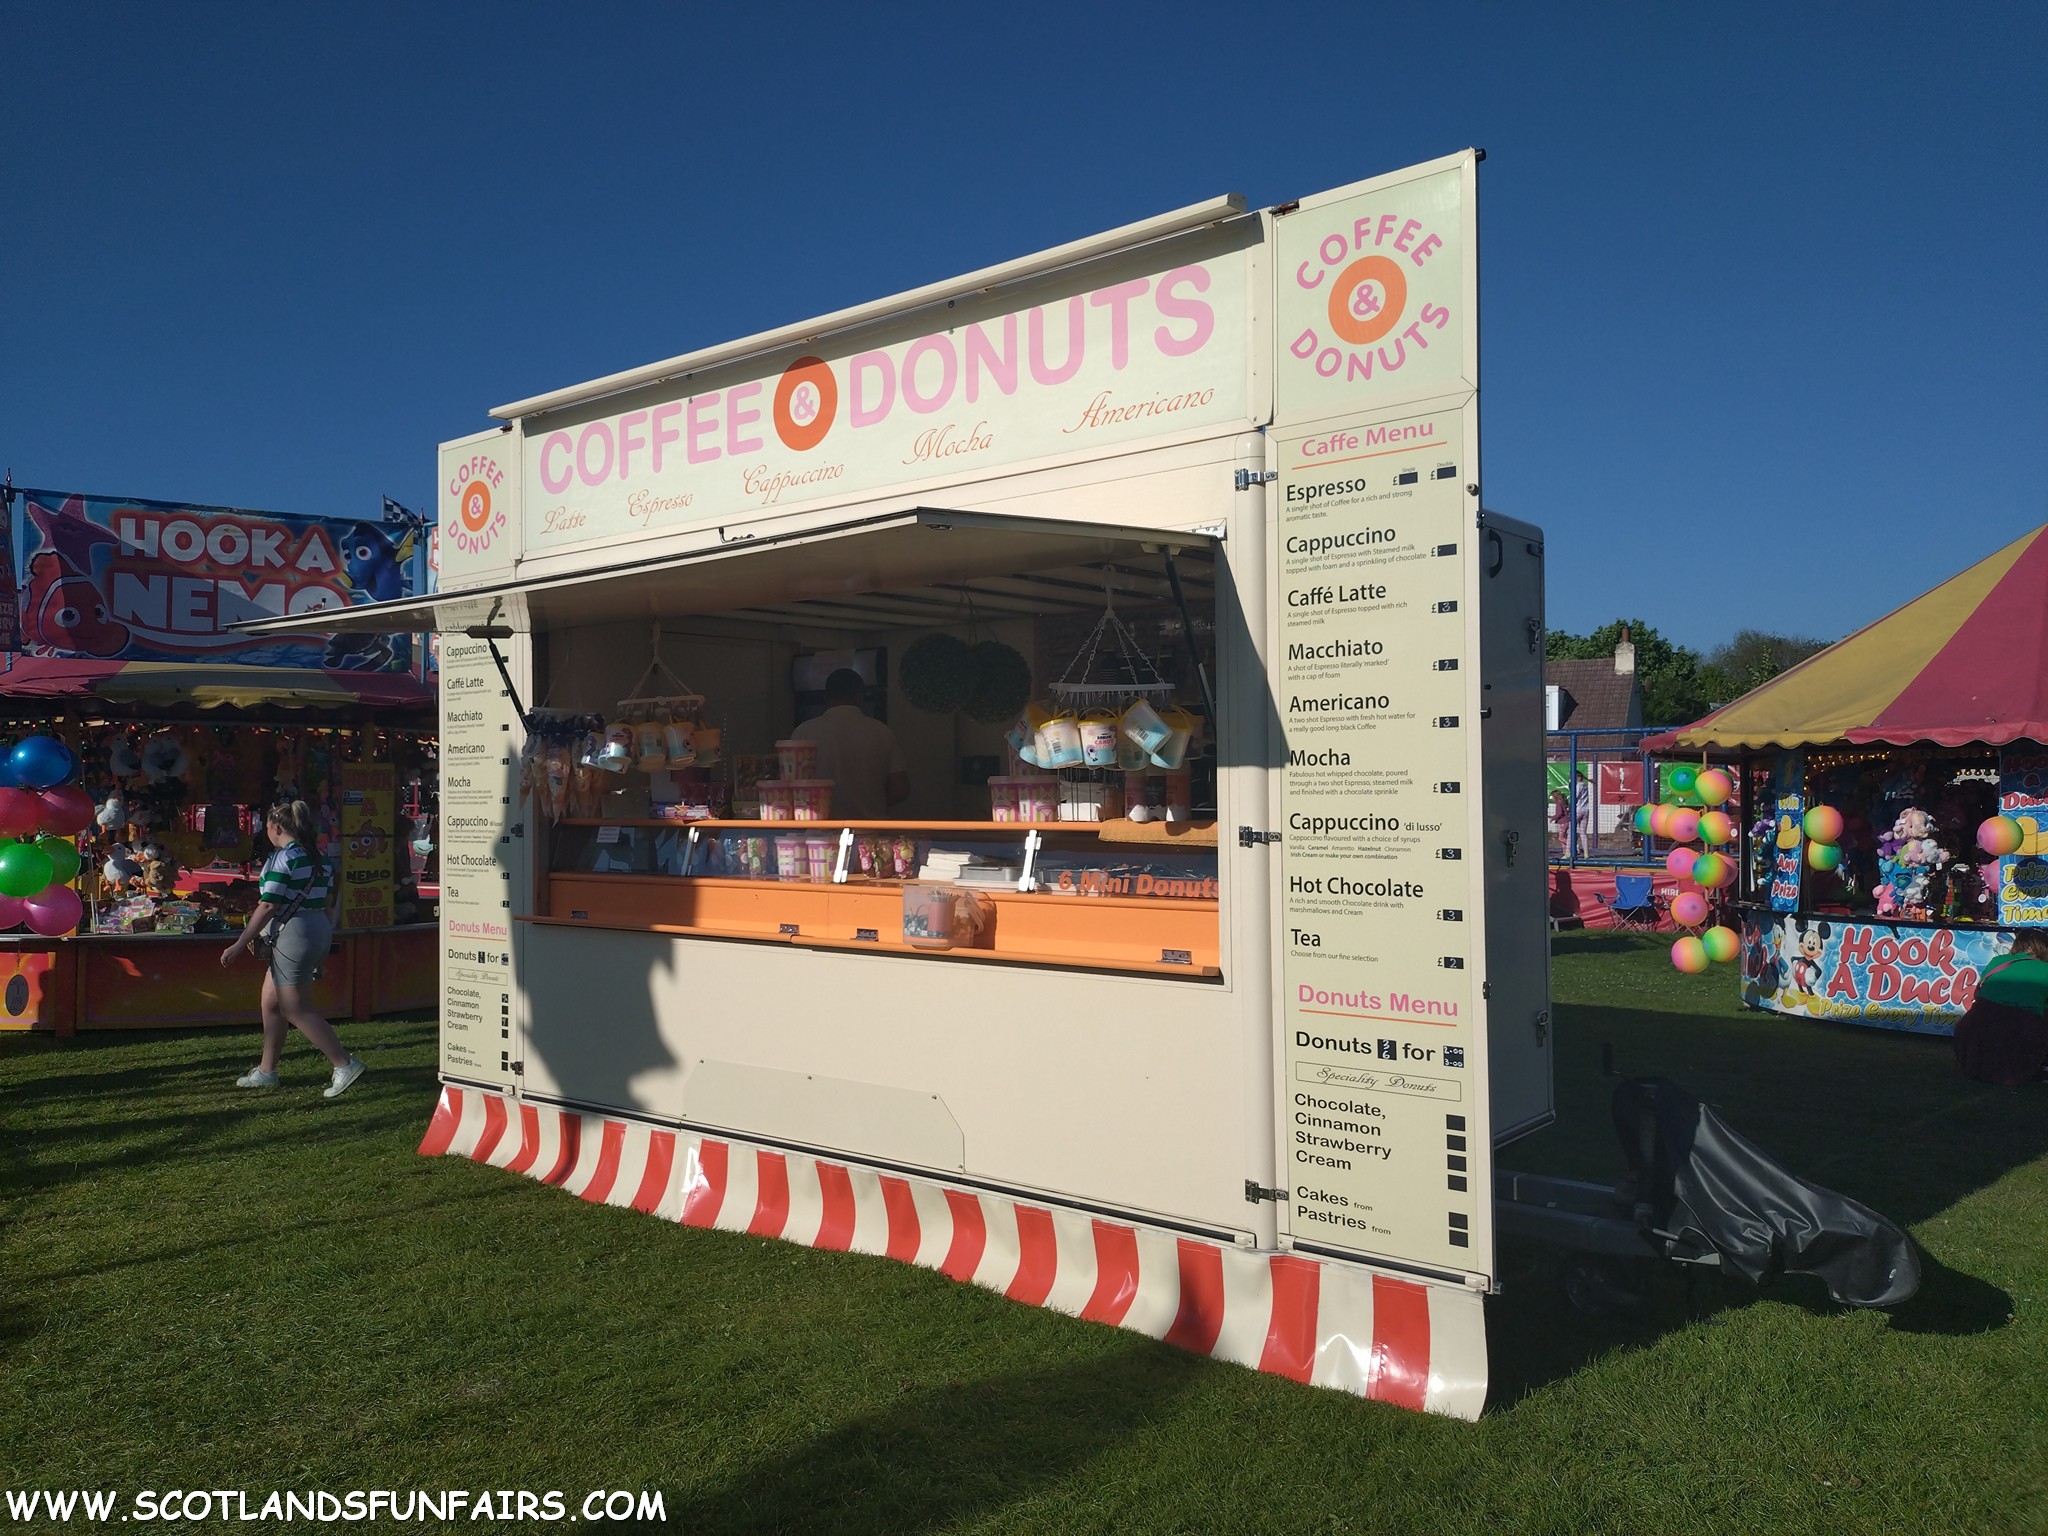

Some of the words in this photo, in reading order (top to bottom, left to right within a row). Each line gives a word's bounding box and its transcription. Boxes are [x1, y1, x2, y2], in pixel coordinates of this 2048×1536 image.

[1297, 215, 1443, 289] COFFEE
[1353, 284, 1380, 315] &
[1290, 303, 1449, 381] DONUTS
[540, 381, 762, 494] COFFEE
[794, 386, 815, 420] &
[850, 265, 1214, 428] DONUTS
[1302, 433, 1358, 456] Caffe
[1366, 423, 1433, 446] Menu
[540, 505, 586, 534] Latte
[628, 489, 693, 526] Espresso
[744, 460, 844, 504] Cappuccino
[903, 420, 993, 465] Mocha
[1063, 388, 1214, 434] Americano
[450, 456, 503, 496] COFFEE
[1287, 478, 1366, 503] Espresso
[471, 496, 481, 515] &
[448, 512, 506, 554] DONUTS
[1286, 527, 1395, 555] Cappuccino
[120, 518, 286, 568] HOOK
[296, 532, 335, 572] A
[1288, 586, 1333, 606] Caffé
[1339, 584, 1386, 602] Latte
[446, 643, 487, 658] Cappuccino
[1289, 640, 1383, 660] Macchiato
[447, 678, 464, 689] Caffé
[466, 677, 484, 687] Latte
[1289, 694, 1390, 712] Americano
[447, 711, 483, 722] Macchiato
[448, 743, 485, 754] Americano
[1290, 749, 1350, 766] Mocha
[2004, 756, 2048, 773] Hoo
[448, 776, 470, 787] Mocha
[1374, 788, 1398, 796] sprinkle
[448, 816, 488, 828] Cappuccino
[1290, 813, 1399, 834] Cappuccino
[447, 855, 459, 865] Hot
[461, 855, 496, 866] Chocolate
[1778, 854, 1797, 874] Any
[346, 870, 391, 880] NEMO
[1059, 871, 1072, 890] 6
[1080, 872, 1130, 893] Mini
[2004, 864, 2048, 881] Priz
[447, 887, 458, 897] Tea
[1290, 876, 1322, 893] Hot
[1327, 877, 1423, 897] Chocolate
[2002, 885, 2048, 899] Ever
[449, 920, 480, 933] Donuts
[483, 923, 507, 935] Menu
[1291, 929, 1320, 947] Tea
[448, 949, 476, 961] Donuts
[487, 953, 499, 963] for
[1291, 950, 1311, 958] Choose
[1352, 954, 1378, 962] selection
[1840, 928, 1956, 976] Hook
[1827, 963, 1858, 999] A
[447, 987, 481, 999] Chocolate,
[1299, 985, 1381, 1009] Donuts
[1390, 993, 1457, 1016] Menu
[447, 998, 479, 1009] Cinnamon
[1820, 1000, 1861, 1017] Prize
[1866, 1004, 1919, 1026] Every
[1923, 1006, 1961, 1024] Tim
[447, 1009, 483, 1023] Strawberry
[447, 1021, 468, 1031] Cream
[448, 1043, 466, 1053] Cakes
[1296, 1031, 1371, 1054] Donuts
[1402, 1043, 1435, 1061] for
[448, 1055, 472, 1066] Pastries
[1317, 1067, 1378, 1088] Speciality
[1385, 1076, 1437, 1092] Donuts
[1295, 1093, 1386, 1119] Chocolate,
[1295, 1112, 1381, 1136] Cinnamon
[1296, 1131, 1391, 1159] Strawberry
[1296, 1150, 1351, 1170] Cream
[1297, 1186, 1348, 1206] Cakes
[1354, 1202, 1372, 1211] from
[1298, 1206, 1366, 1229] Pastries
[1372, 1226, 1391, 1235] from
